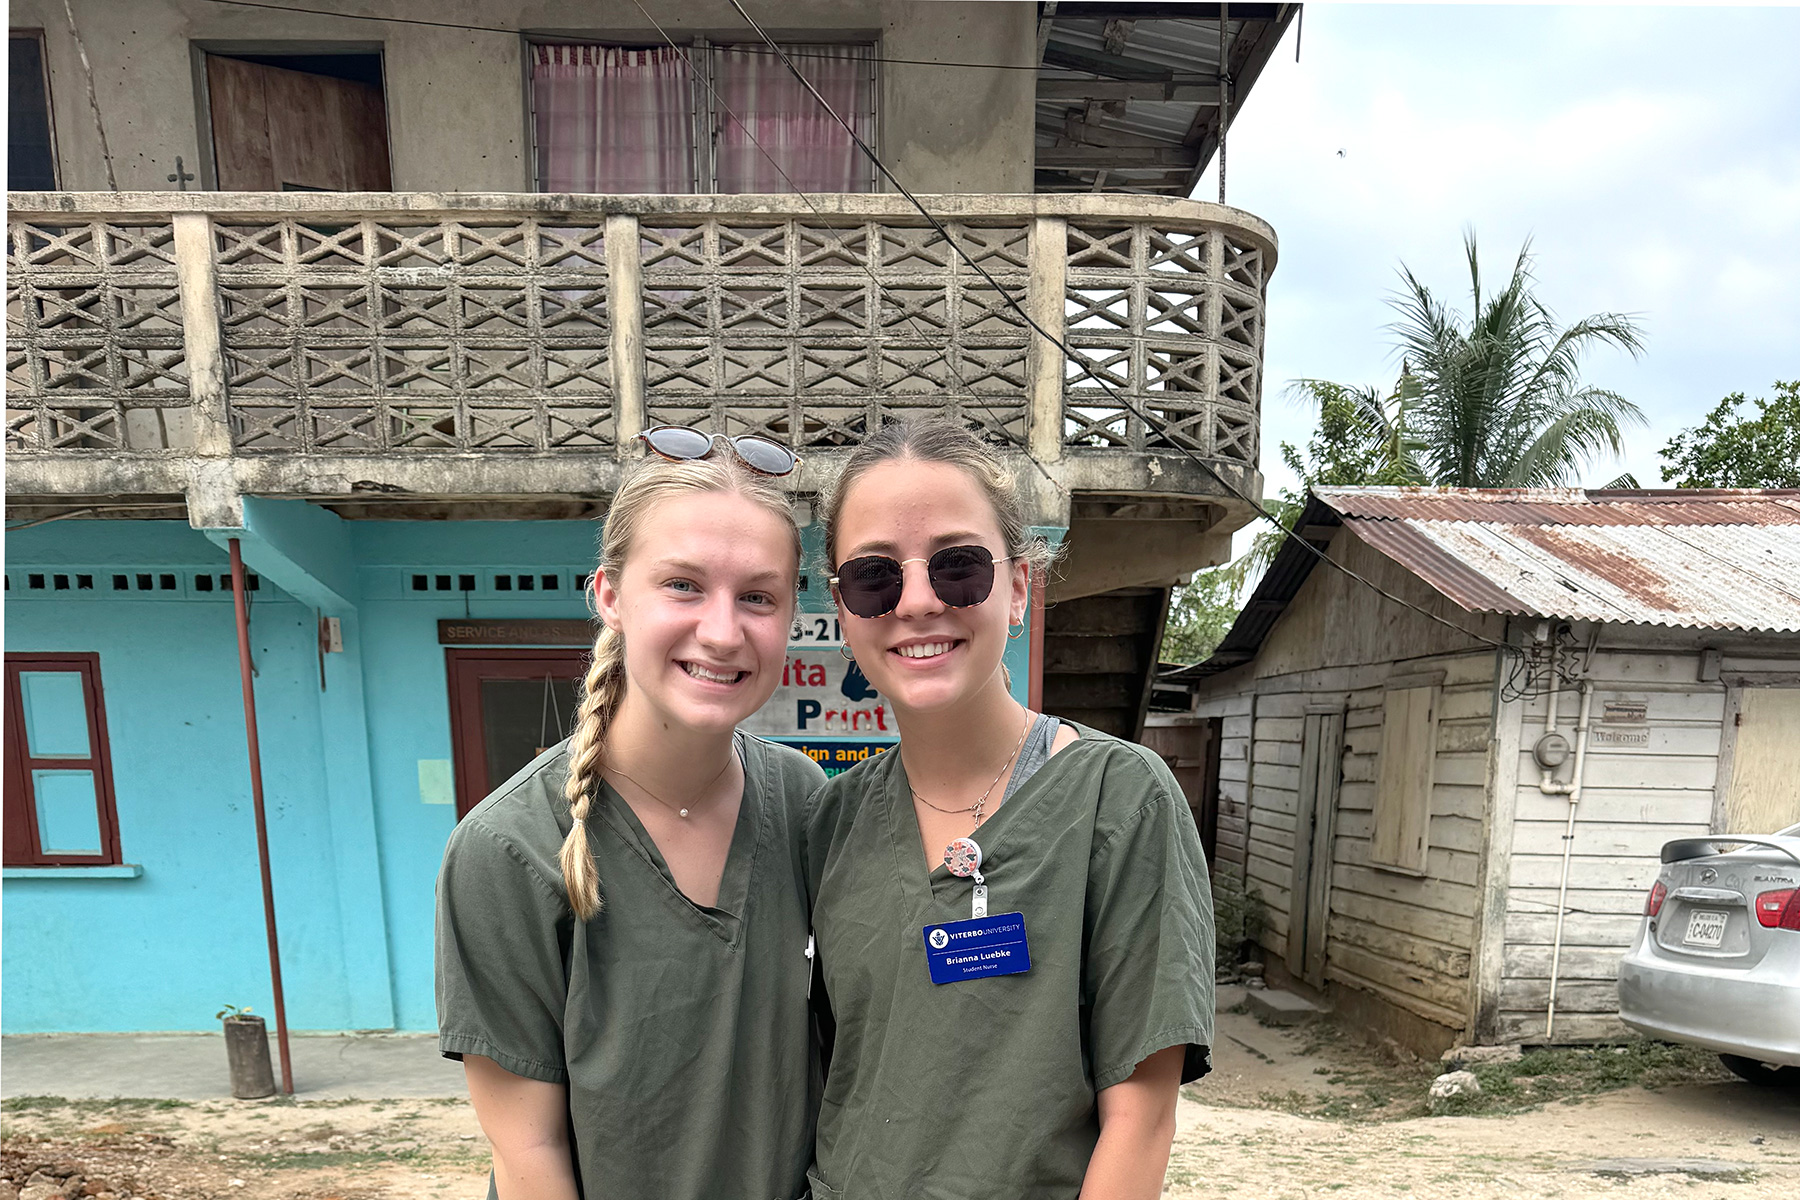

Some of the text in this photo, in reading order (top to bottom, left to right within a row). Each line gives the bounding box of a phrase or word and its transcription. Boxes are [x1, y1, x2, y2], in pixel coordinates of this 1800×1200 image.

[447, 626, 505, 638] SERVICE
[797, 699, 888, 731] Print
[835, 746, 869, 761] and
[946, 949, 1011, 965] Brianna Luebke
[962, 962, 998, 974] Student Nurse
